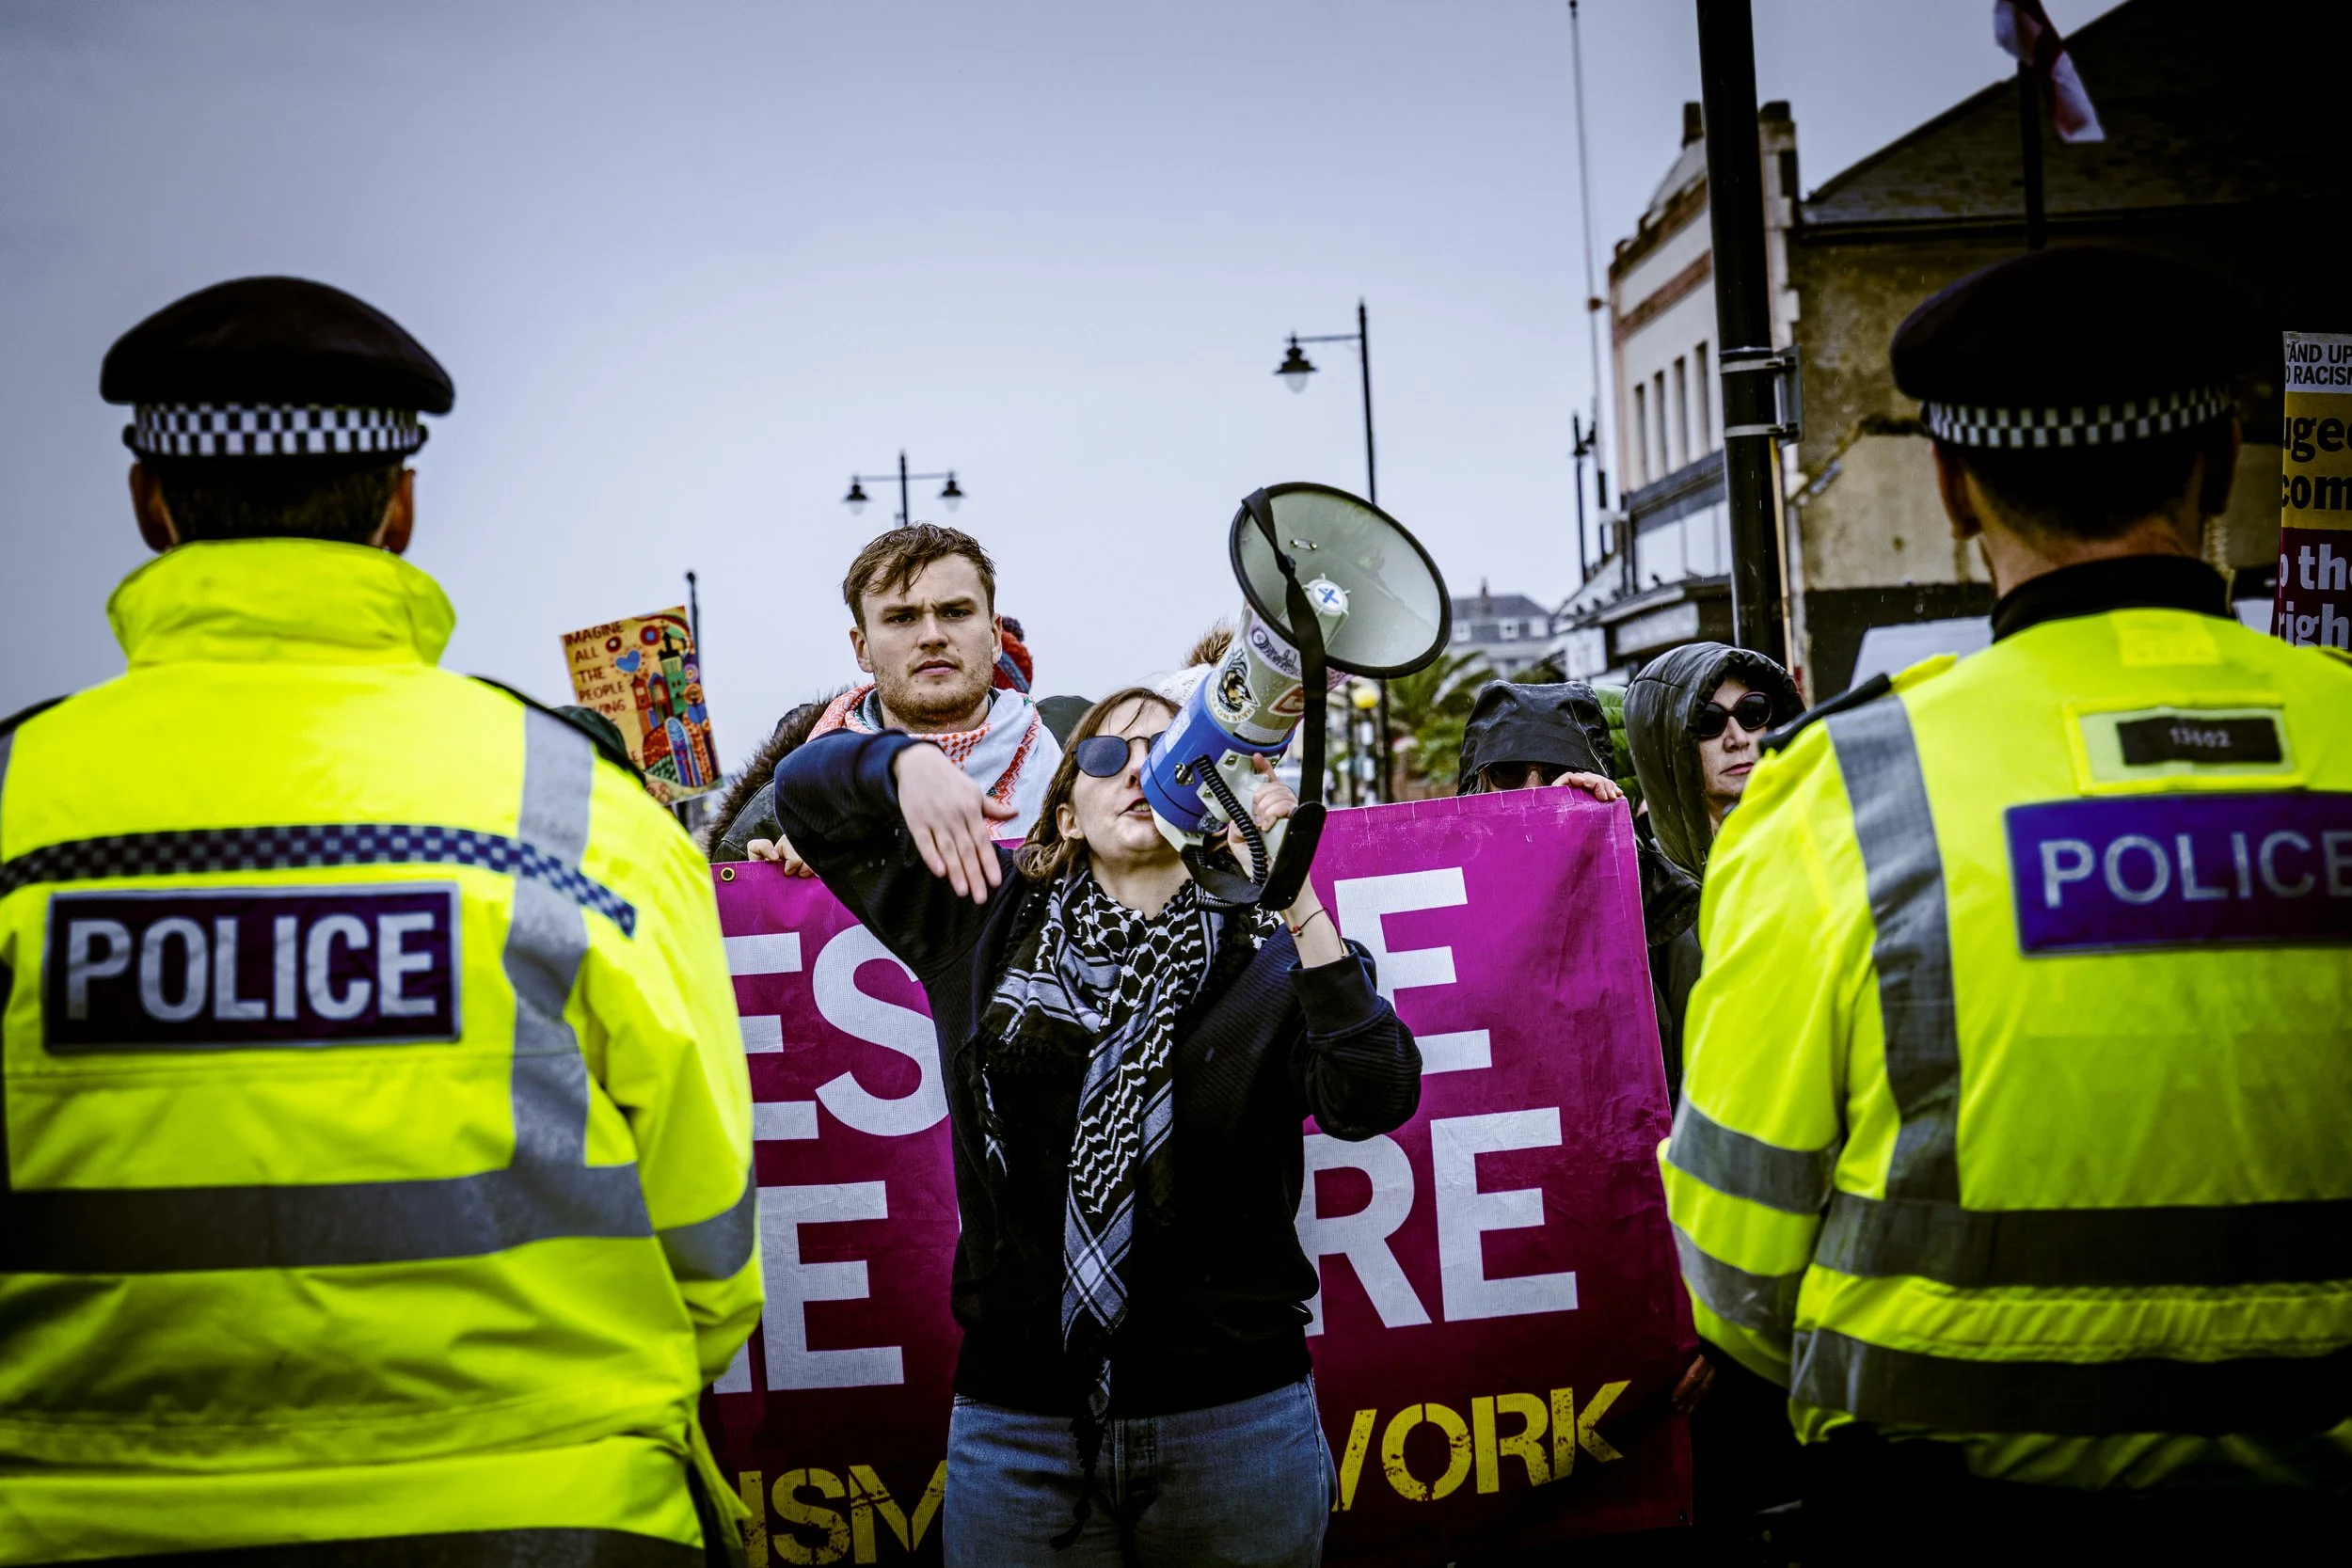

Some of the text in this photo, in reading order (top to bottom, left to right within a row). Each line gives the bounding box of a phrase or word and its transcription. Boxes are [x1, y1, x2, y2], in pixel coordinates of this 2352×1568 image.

[2287, 343, 2322, 363] AND
[2298, 544, 2352, 591] th
[564, 621, 624, 646] IMAGINE
[575, 646, 599, 663] ALL
[578, 667, 606, 683] THE
[579, 681, 625, 703] PEOPLE
[2039, 830, 2352, 909] POLICE
[66, 911, 437, 1022] POLICE
[713, 1180, 904, 1394] E
